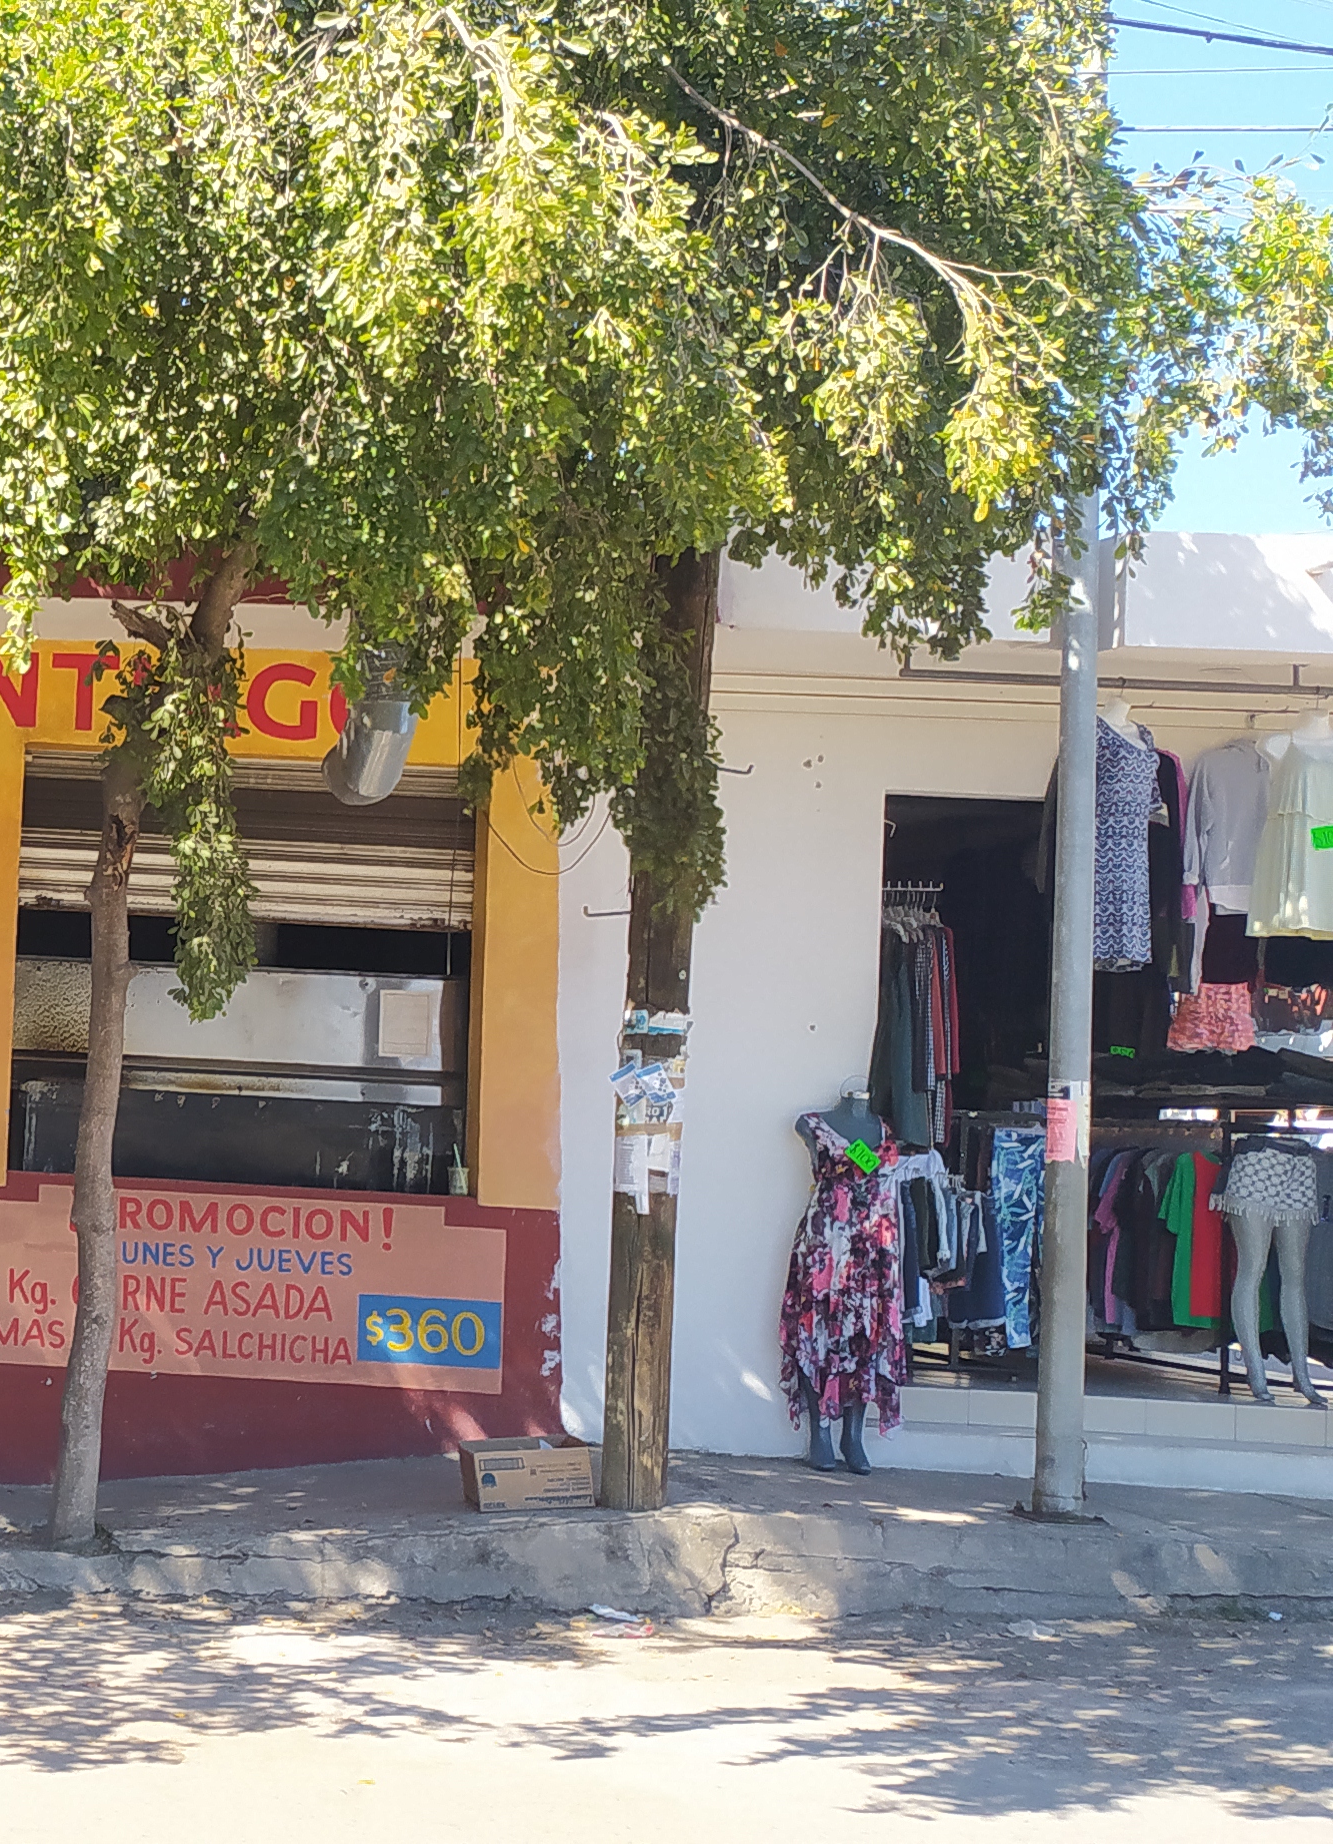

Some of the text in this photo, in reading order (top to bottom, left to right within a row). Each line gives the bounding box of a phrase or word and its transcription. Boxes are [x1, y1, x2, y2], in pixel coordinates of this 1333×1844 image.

[69, 1195, 394, 1252] ROMOCION!
[121, 1241, 353, 1276] UNES Y JUEVES
[204, 1279, 334, 1323] ASADA
[118, 1318, 163, 1365] Kg.
[174, 1326, 353, 1366] SALCHICHA
[364, 1306, 486, 1357] $360
